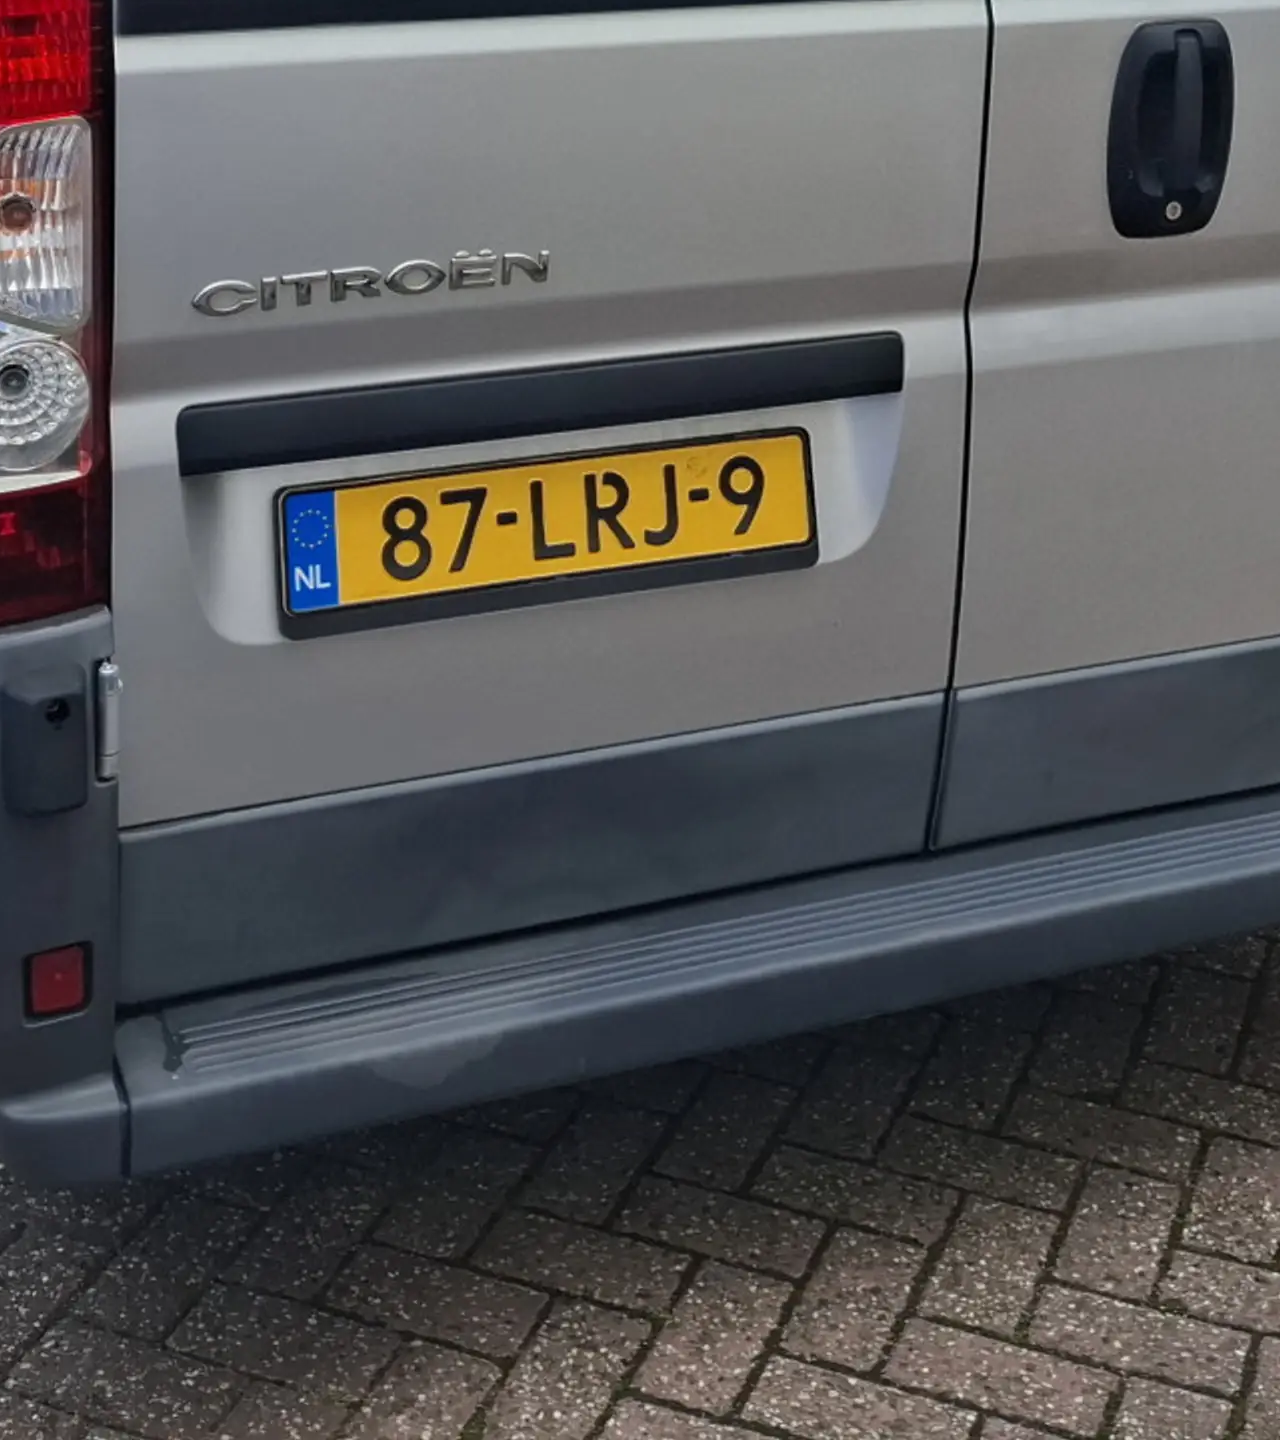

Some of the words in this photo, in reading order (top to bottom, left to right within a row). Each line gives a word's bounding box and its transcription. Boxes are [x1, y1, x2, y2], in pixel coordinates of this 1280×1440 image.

[191, 249, 550, 316] CITROËN
[381, 455, 764, 581] 87-LRJ-9
[294, 564, 331, 592] NL
